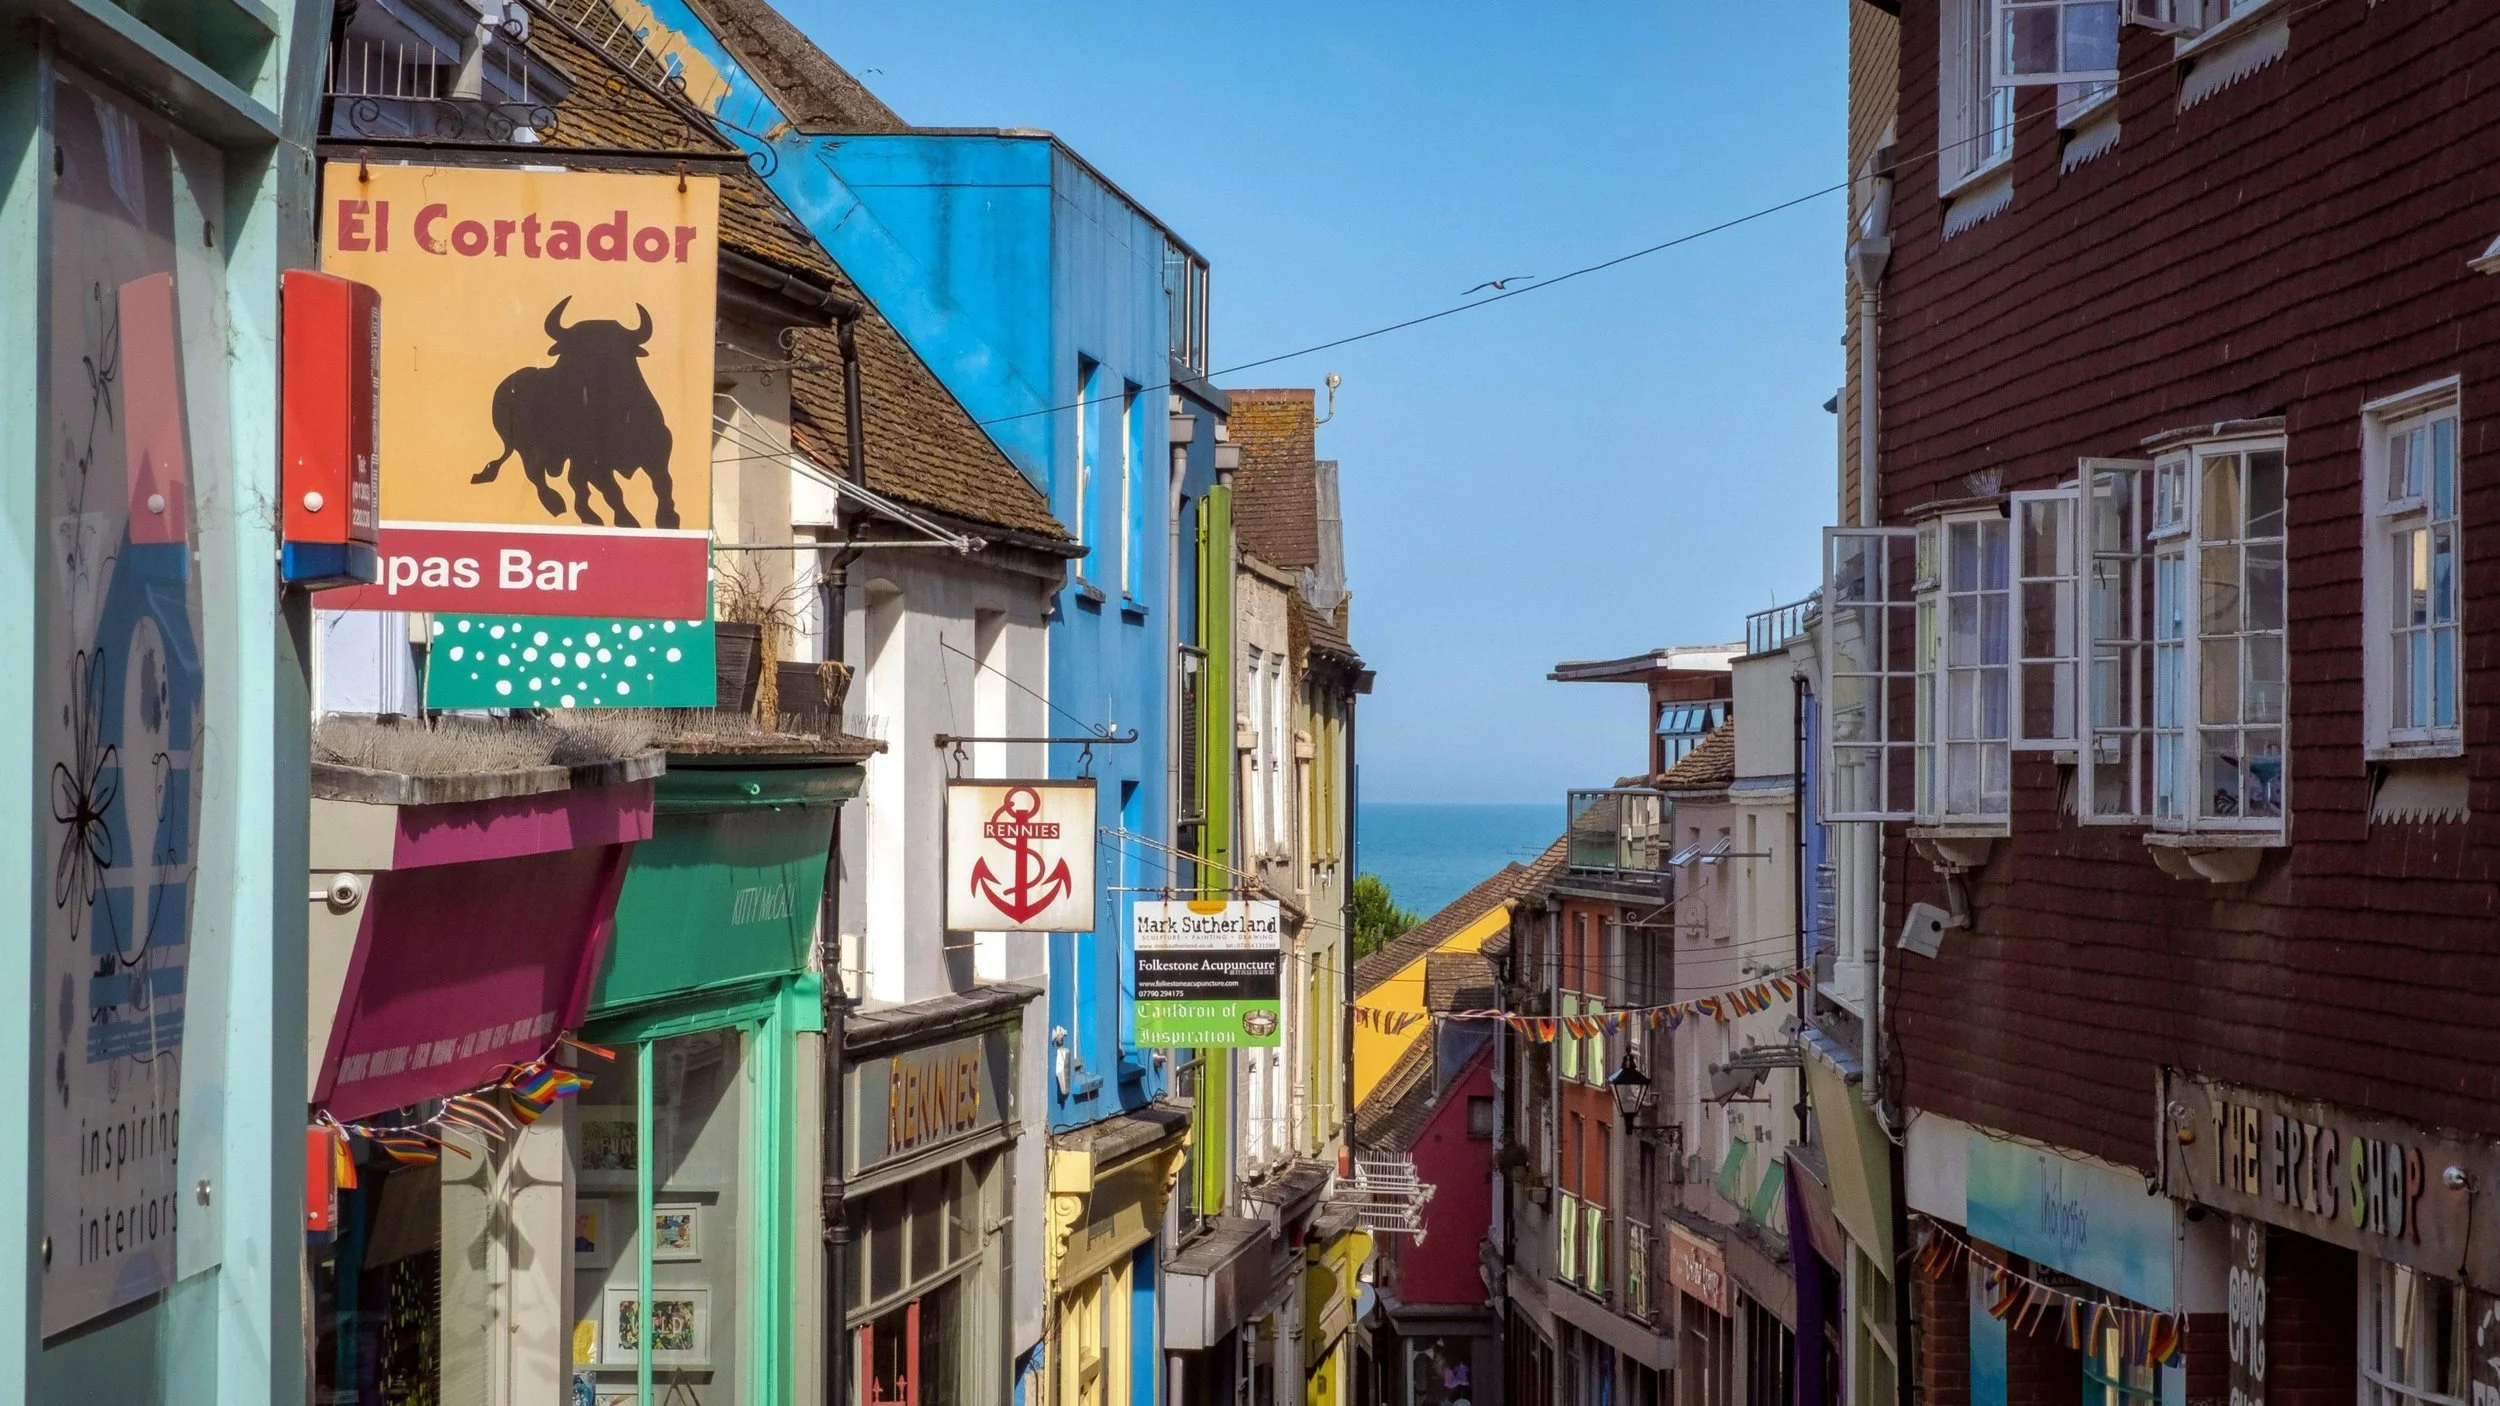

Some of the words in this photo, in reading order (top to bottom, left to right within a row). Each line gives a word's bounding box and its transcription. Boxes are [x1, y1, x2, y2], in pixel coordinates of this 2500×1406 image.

[338, 200, 389, 253] El
[413, 203, 697, 263] Cortador
[374, 554, 480, 596] pas
[498, 548, 589, 591] Bar
[986, 824, 1059, 837] RENNIES
[731, 886, 762, 926] KITTY
[1137, 916, 1178, 933] Mark
[1182, 916, 1277, 934] Sutherland
[1138, 959, 1199, 971] Folkestone
[1200, 959, 1275, 974] Acupuncture
[1138, 980, 1239, 988] www.folkestoneacupuncture.com
[1138, 990, 1159, 998] 07790
[1160, 990, 1185, 998] 294175
[1137, 1003, 1215, 1018] Cauldron
[1222, 1003, 1237, 1018] of
[1139, 1027, 1236, 1045] Inspiration
[887, 1051, 980, 1156] RENNIES
[80, 1100, 180, 1182] inspiring
[2211, 1100, 2262, 1196] THE
[2271, 1113, 2340, 1219] EPIC
[2350, 1135, 2425, 1246] SHOP
[79, 1188, 178, 1266] interiors
